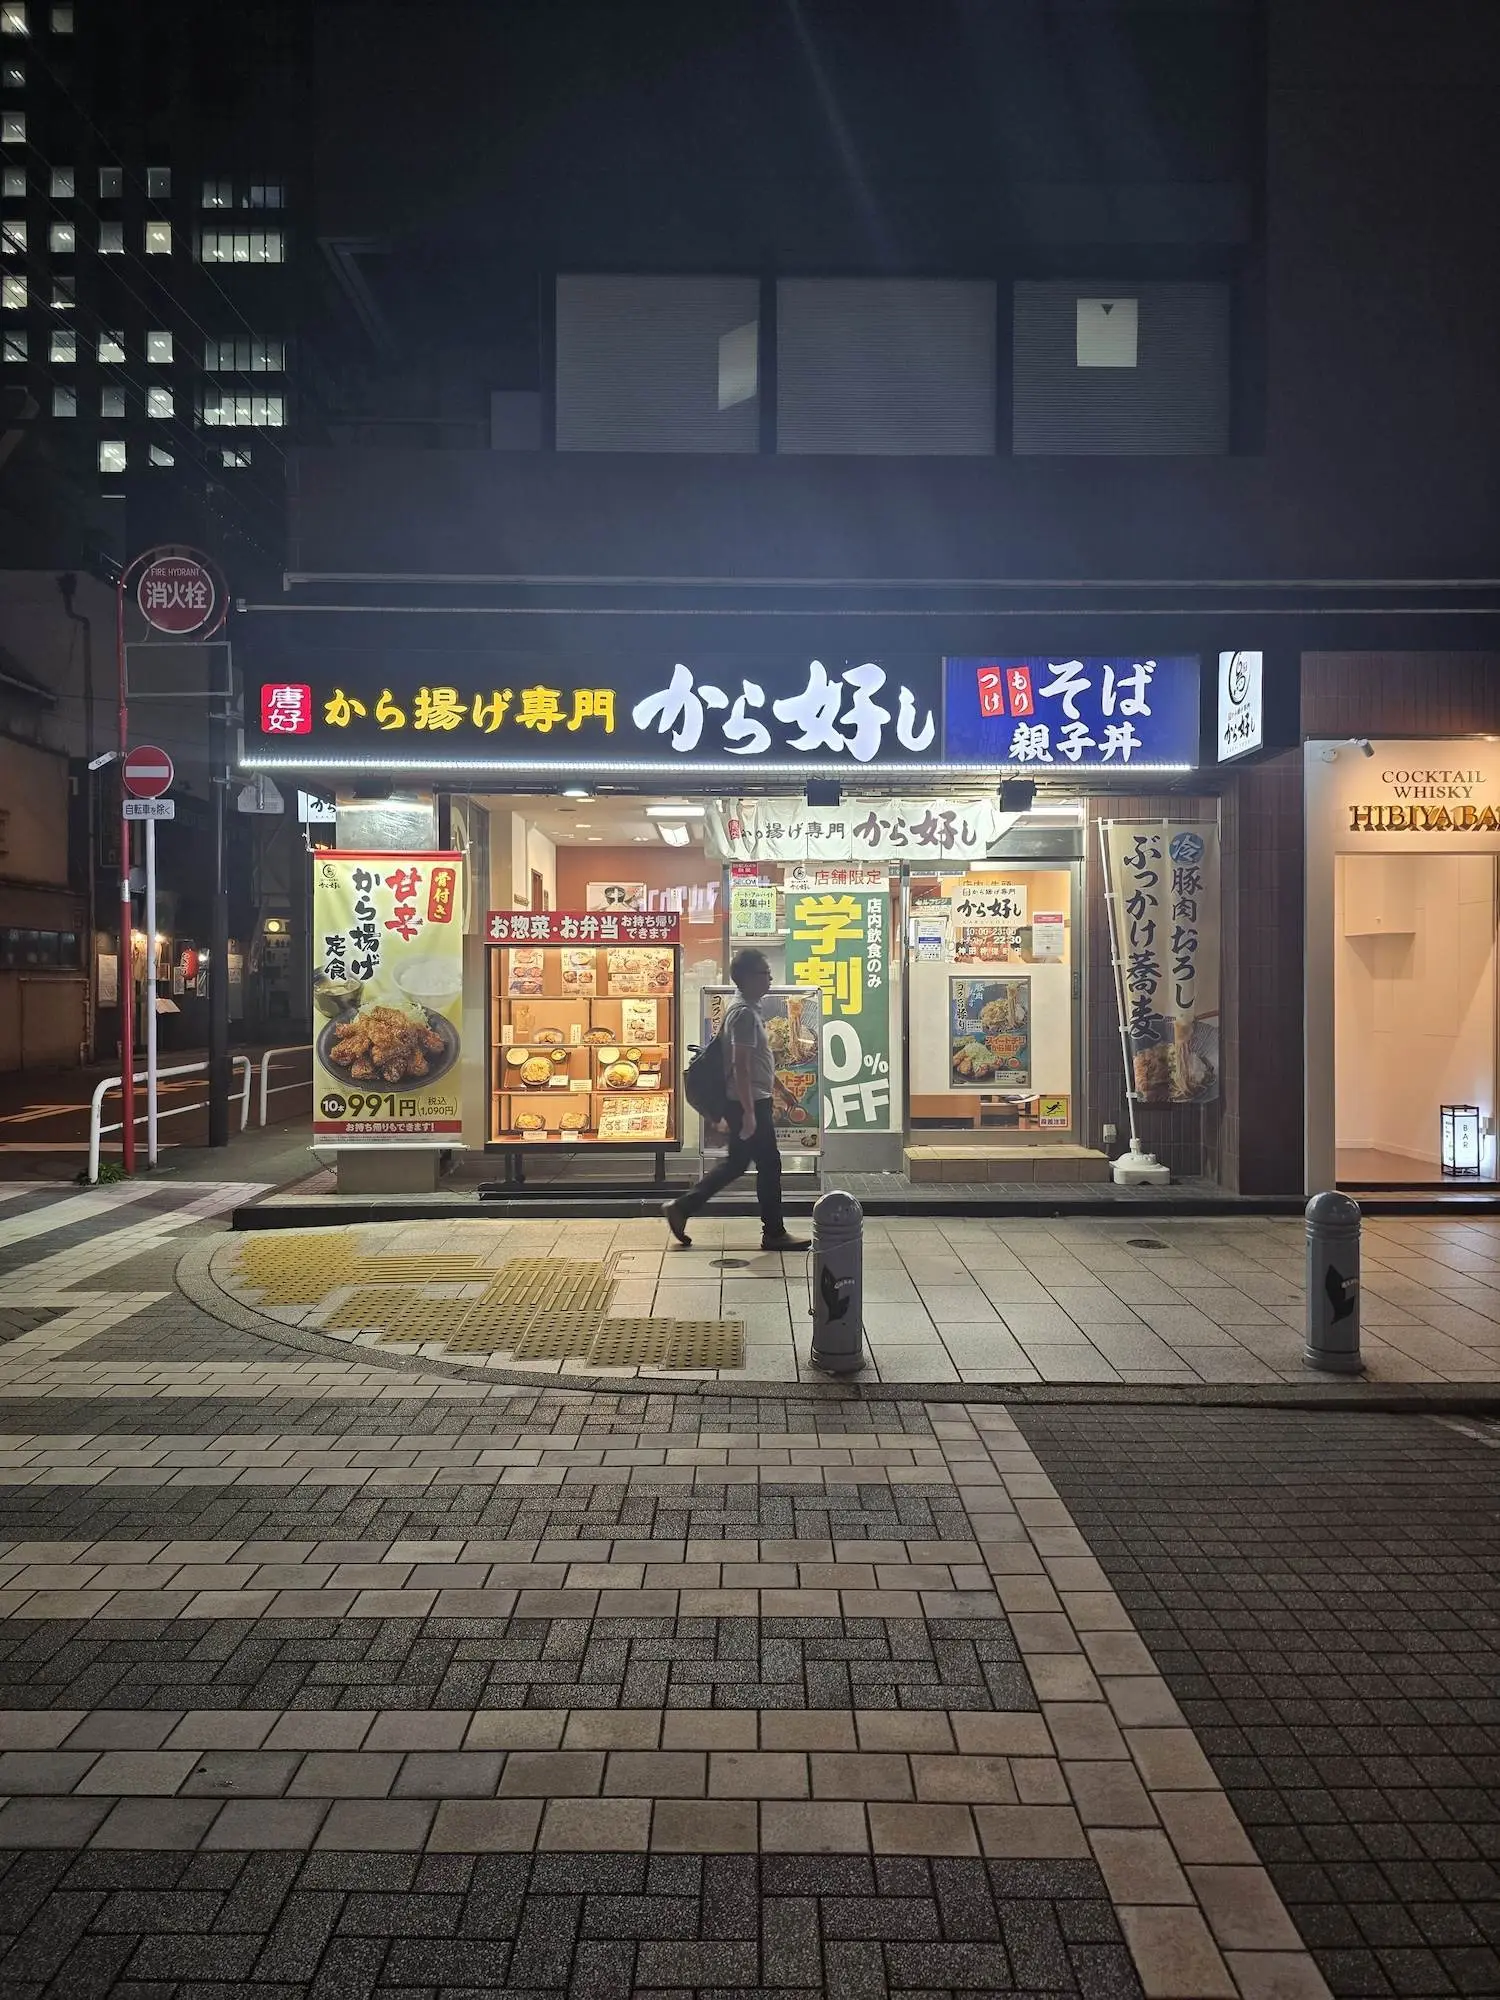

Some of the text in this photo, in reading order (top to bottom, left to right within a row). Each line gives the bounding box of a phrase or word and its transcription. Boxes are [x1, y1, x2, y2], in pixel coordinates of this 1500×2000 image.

[151, 567, 200, 577] FIRE HYDRANT
[146, 580, 207, 610] 消火栓
[267, 686, 305, 733] 唐好
[981, 671, 1001, 712] つけ
[1011, 671, 1030, 715] もり
[1038, 661, 1154, 720] そば
[323, 660, 936, 763] から揚げ専門 から好し
[1224, 712, 1256, 745] から好し
[1010, 722, 1142, 763] 親子丼
[1382, 770, 1487, 784] COCKTAIL
[1393, 786, 1473, 799] WHISKY
[125, 804, 171, 816] 自転車を除く
[1349, 805, 1500, 832] HIBIYA BA
[853, 811, 977, 849] から好し
[432, 872, 451, 919] 骨付き
[814, 868, 882, 886] 店舗限定
[384, 866, 425, 942] 甘辛
[621, 915, 677, 927] お持ち帰り
[957, 898, 1022, 919] から好し
[1171, 833, 1204, 1009] 冷 豚肉おろし
[349, 868, 382, 982] から揚げ
[490, 915, 618, 940] お惣菜・お弁当
[627, 927, 671, 939] できます
[867, 898, 883, 988] 店内飲食のみ
[1123, 836, 1164, 1041] ぶっかけ蕎麦
[325, 935, 347, 981] 定食
[793, 895, 864, 1015] 学割
[347, 1093, 416, 1117] 991円
[428, 1097, 447, 1106] 税込
